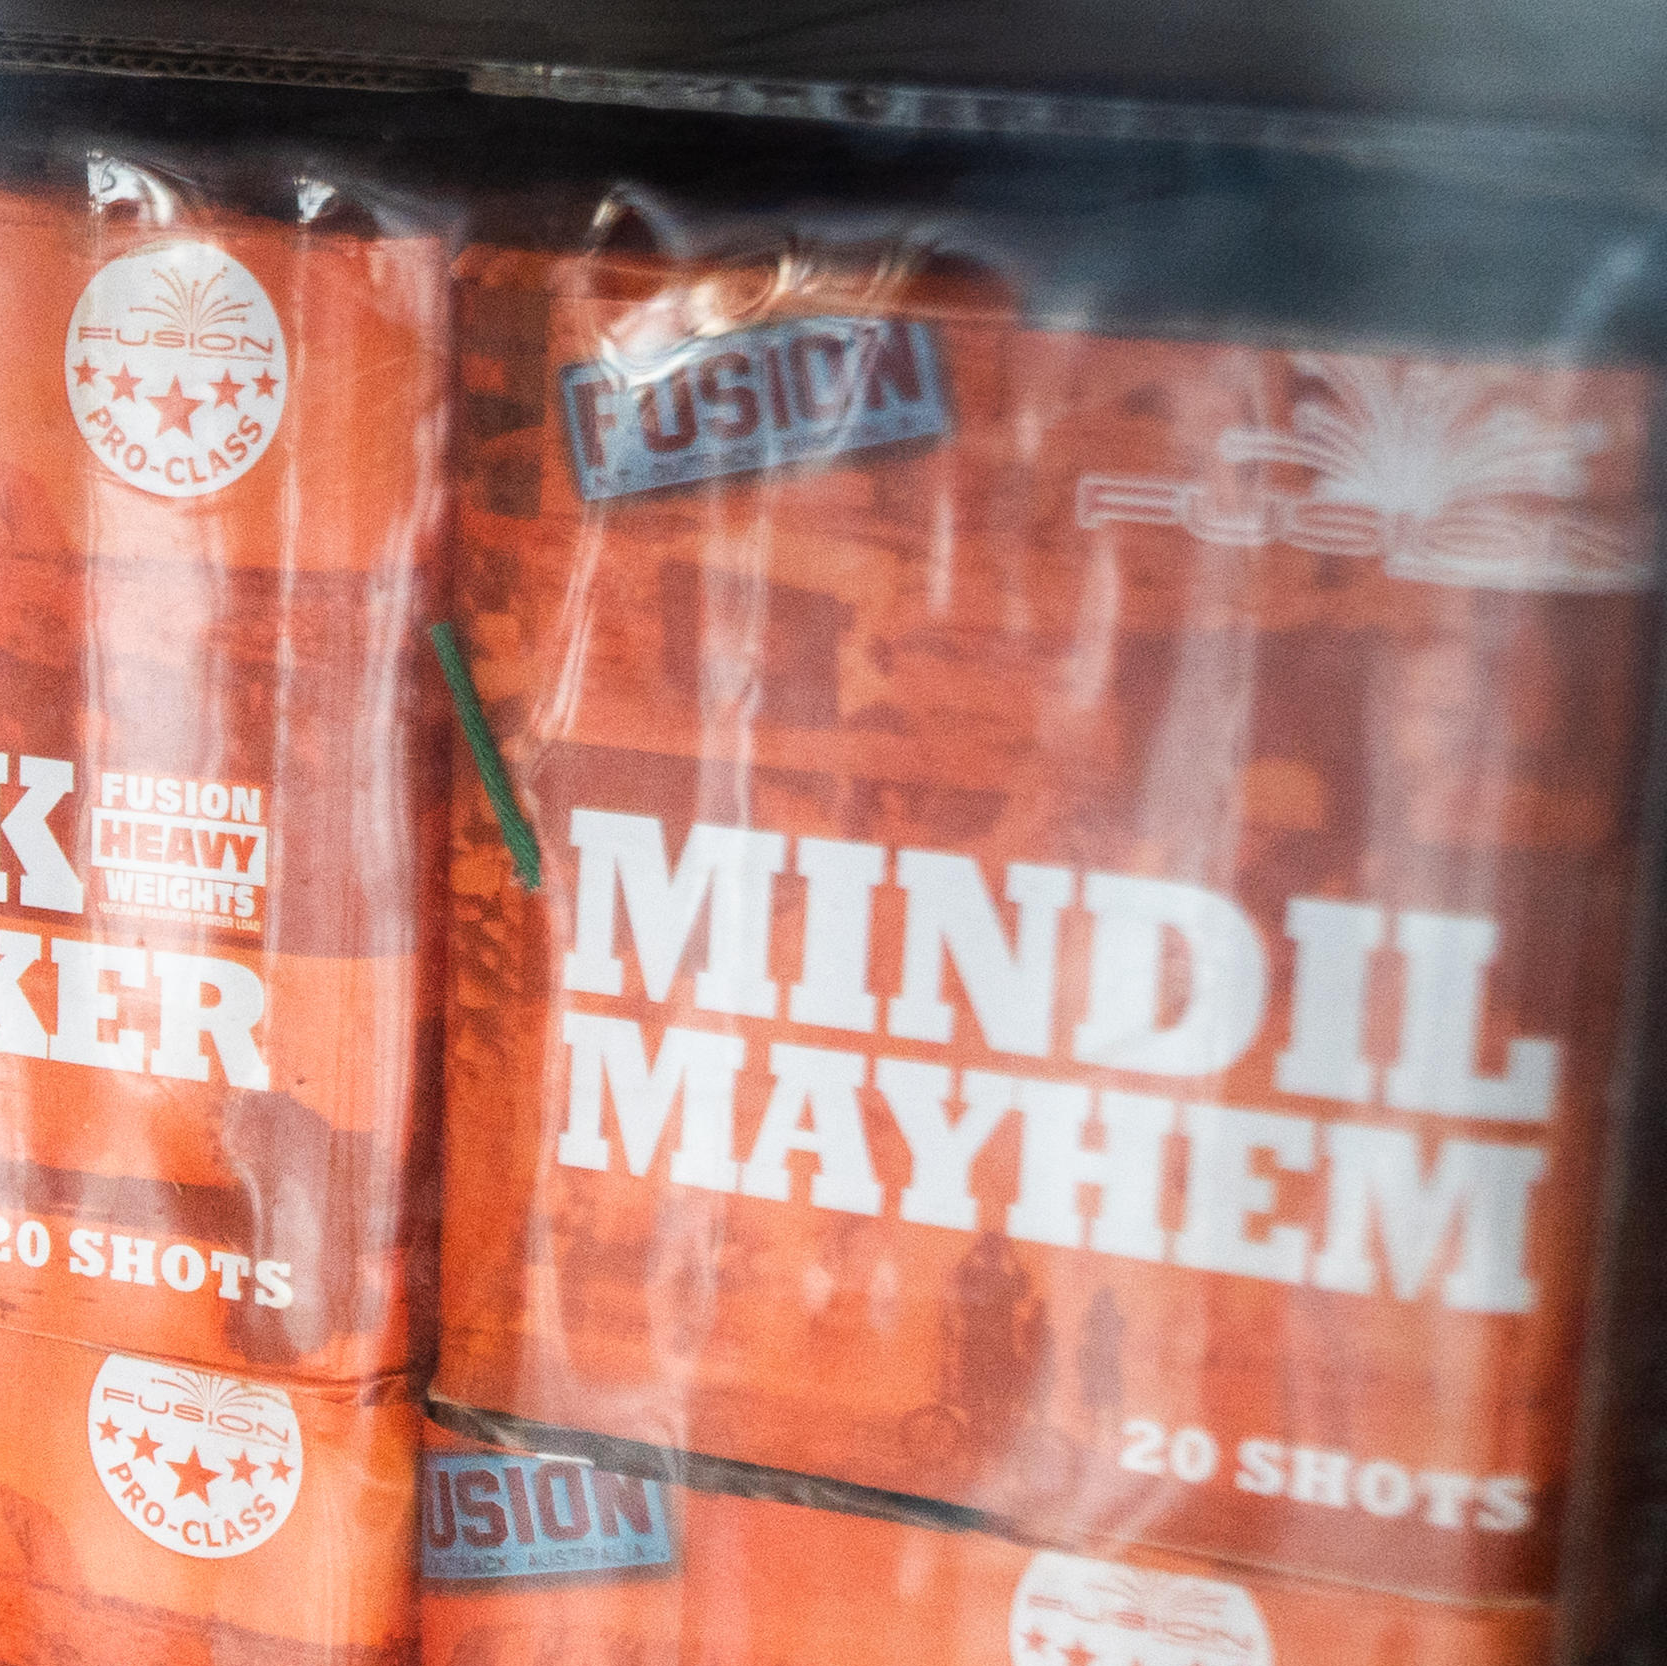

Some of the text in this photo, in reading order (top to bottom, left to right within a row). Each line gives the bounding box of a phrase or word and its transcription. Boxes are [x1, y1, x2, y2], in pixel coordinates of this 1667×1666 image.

[78, 326, 273, 356] FUSION
[573, 321, 924, 470] FUSION
[85, 405, 263, 486] PRO-CLASS
[101, 772, 262, 823] FUSION
[100, 818, 259, 875] HEAVY
[104, 869, 256, 918] WEIGHTS
[563, 807, 1562, 1125] MINDIL
[557, 1010, 1548, 1316] MAYHEM
[67, 1228, 295, 1310] SHOTS
[102, 1386, 290, 1445] FUSION
[108, 1461, 277, 1548] PRO-CLASS
[423, 1461, 653, 1549] USION
[1117, 1416, 1538, 1536] 20 SHOTS
